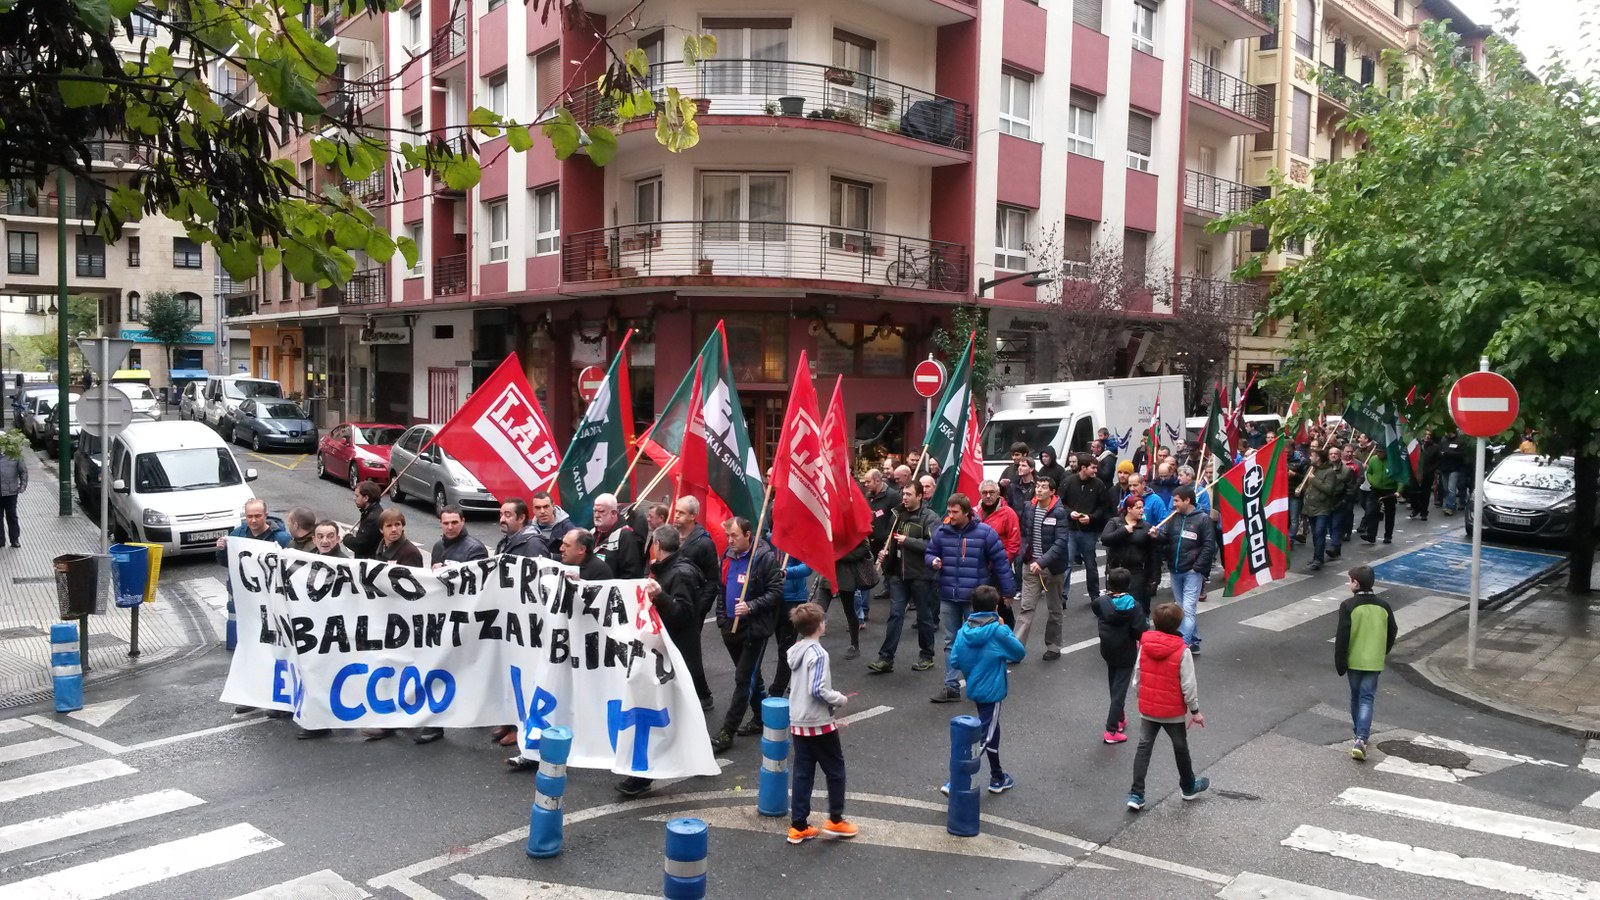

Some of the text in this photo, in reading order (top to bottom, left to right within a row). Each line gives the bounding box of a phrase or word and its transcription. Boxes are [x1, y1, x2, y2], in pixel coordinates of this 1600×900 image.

[490, 390, 558, 472] LAB
[1246, 497, 1267, 569] CCOO
[330, 662, 457, 722] CCOO
